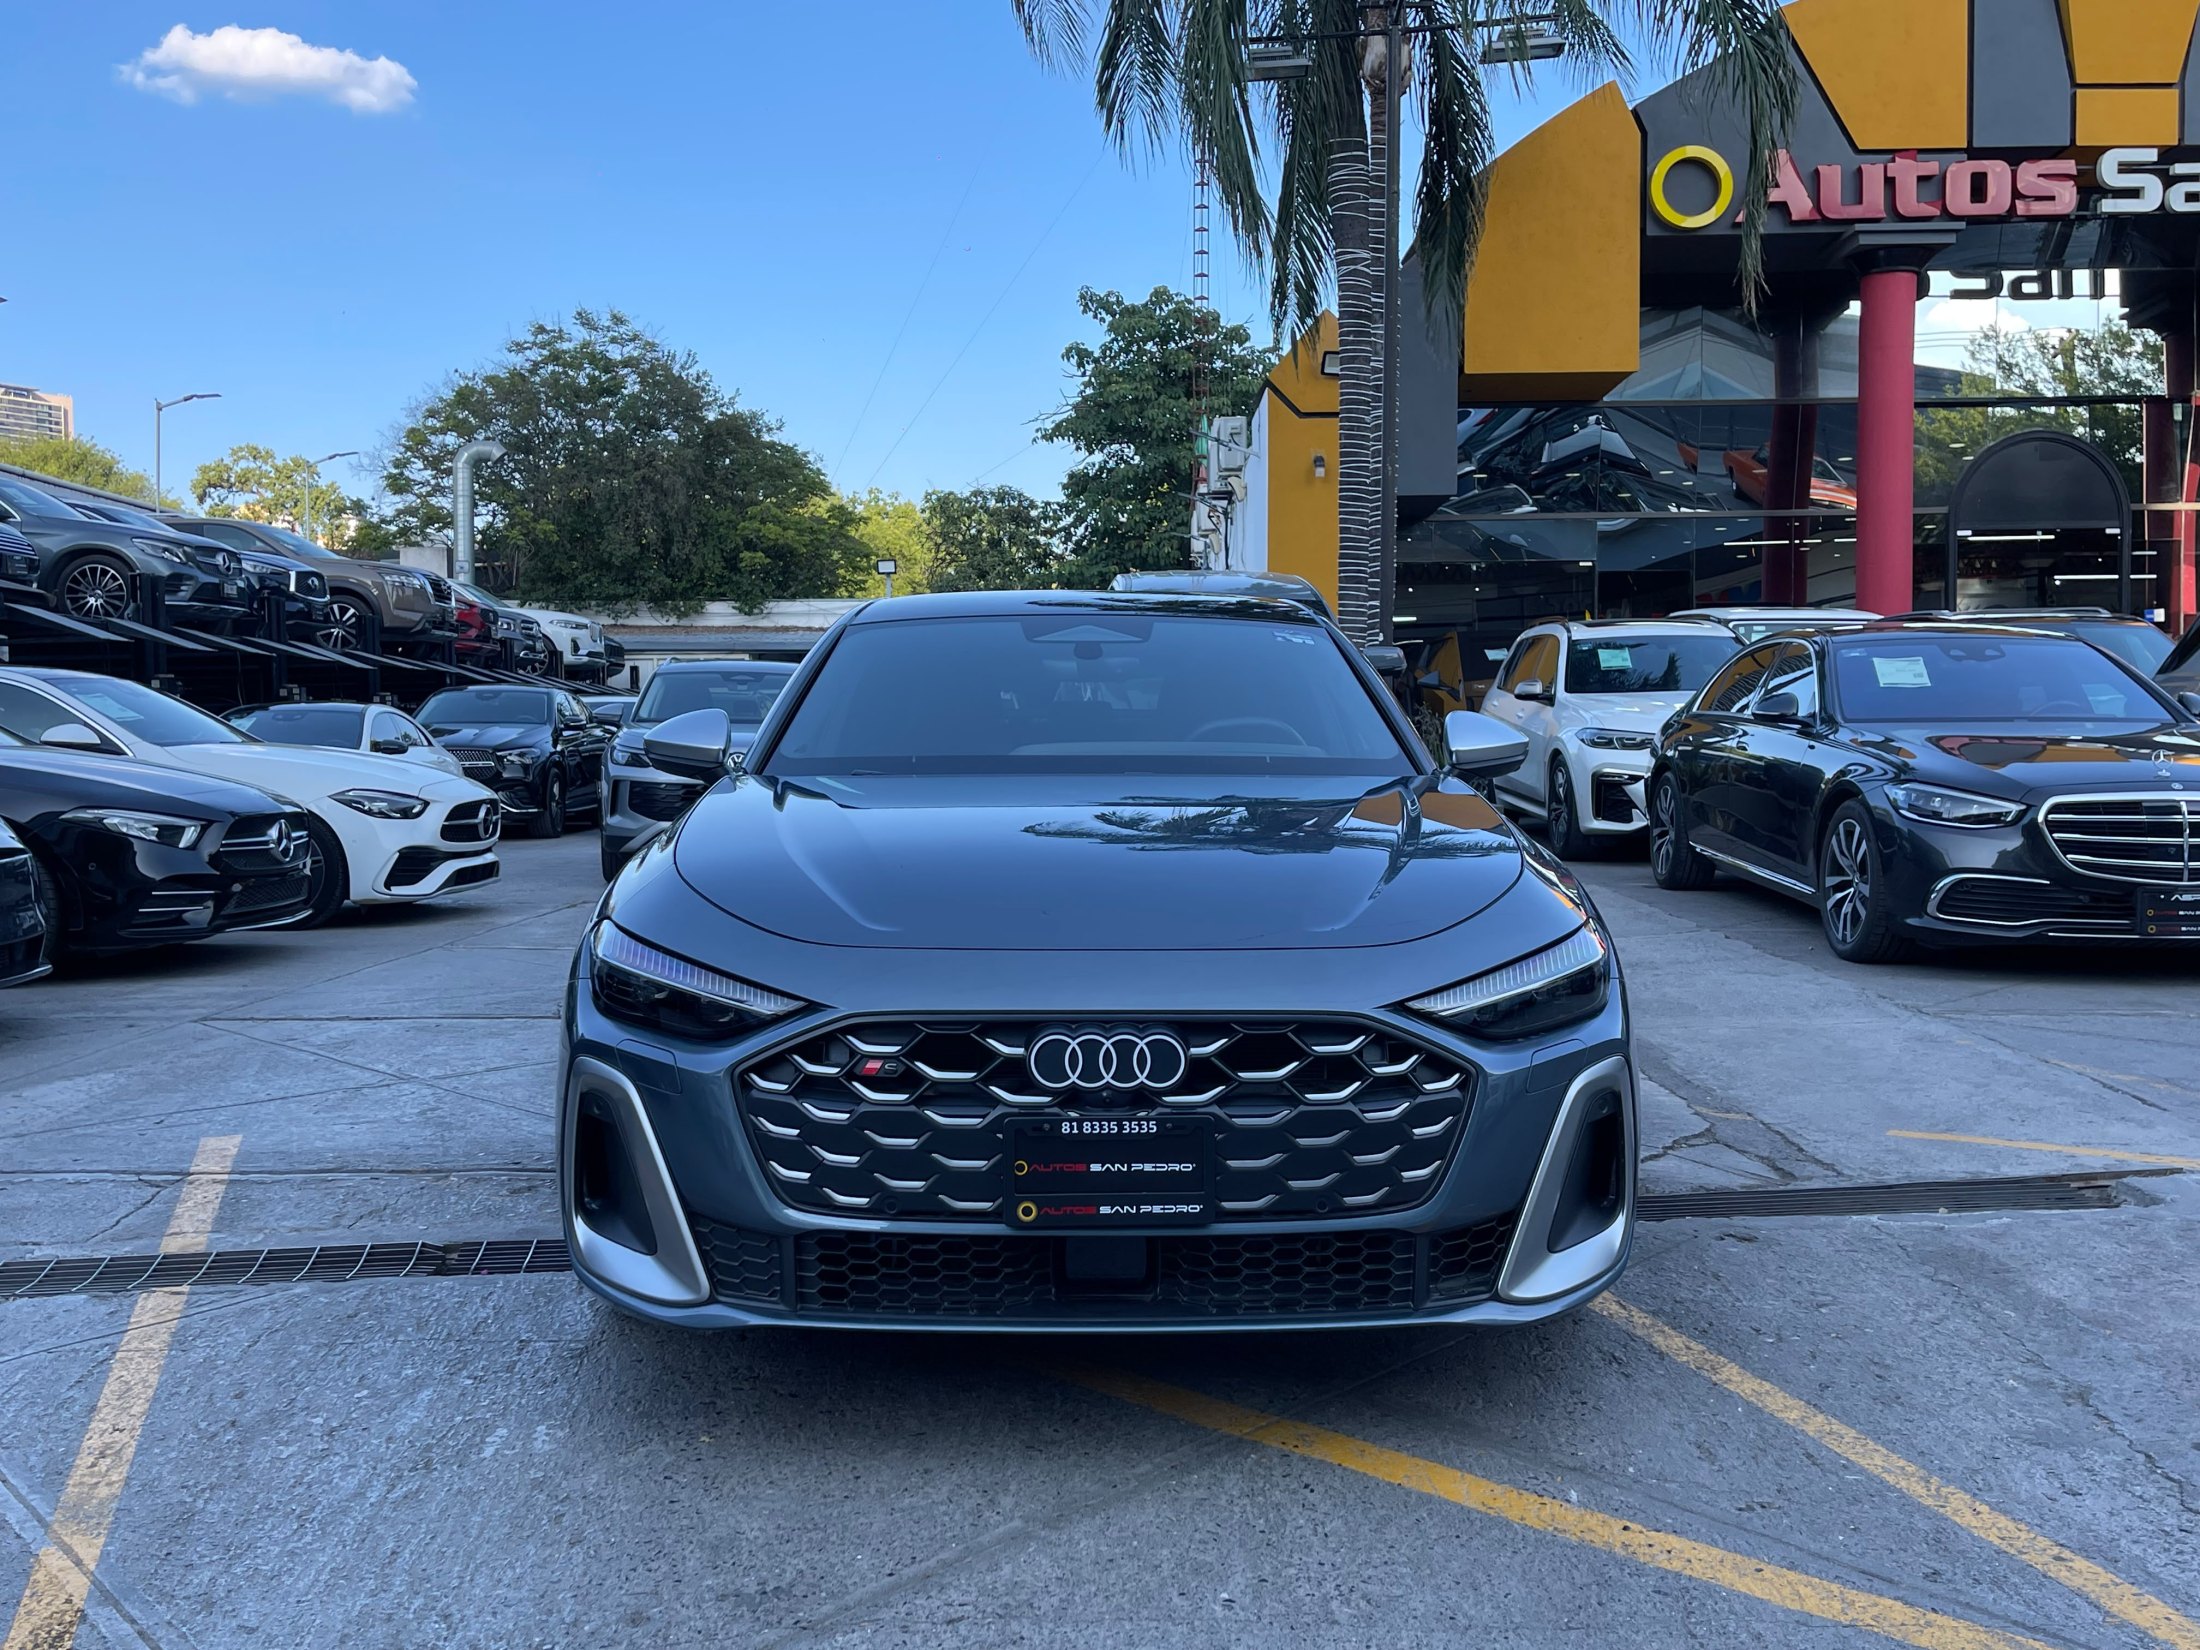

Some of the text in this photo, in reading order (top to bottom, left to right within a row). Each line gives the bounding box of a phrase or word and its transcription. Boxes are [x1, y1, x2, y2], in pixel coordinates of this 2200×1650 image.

[1734, 148, 2078, 222] Autos
[1061, 1120, 1157, 1134] 81 8335 3535
[1029, 1163, 1088, 1172] AUTOS
[1089, 1163, 1128, 1172] SAN
[1040, 1206, 1097, 1215] AUTOS
[1099, 1205, 1136, 1214] SAN
